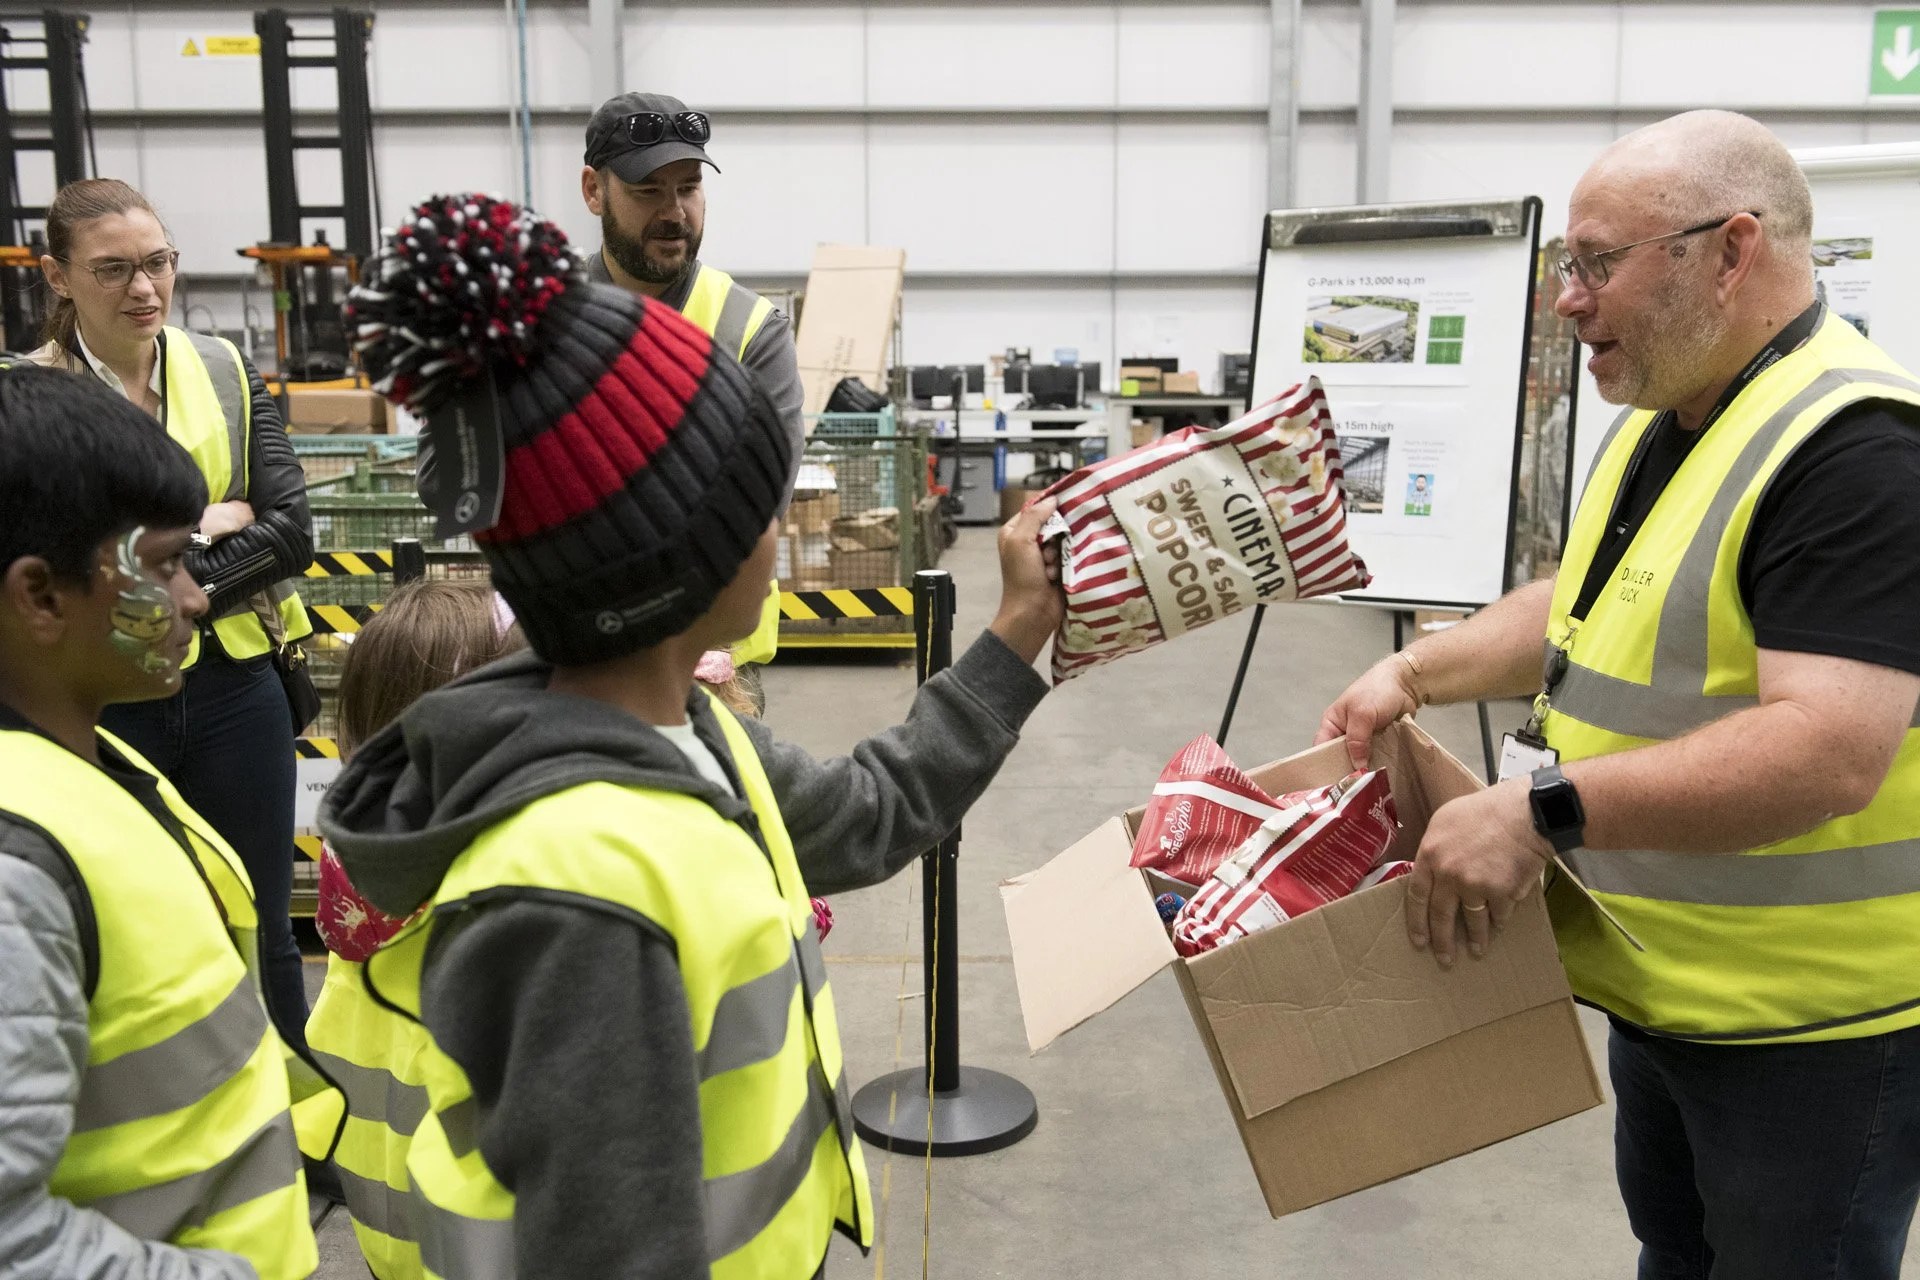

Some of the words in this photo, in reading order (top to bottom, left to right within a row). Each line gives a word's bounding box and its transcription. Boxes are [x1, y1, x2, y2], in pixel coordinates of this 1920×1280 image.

[1307, 276, 1343, 287] G-Park
[1346, 276, 1355, 286] is
[1359, 276, 1394, 287] 13,000
[1397, 276, 1425, 287] sq.m
[1345, 420, 1368, 431] 15m
[1370, 421, 1394, 433] high
[1170, 478, 1218, 551] SWEET
[1206, 556, 1226, 576] &
[1223, 493, 1285, 598] CINEMA
[1134, 488, 1216, 632] POPCOR
[1166, 840, 1183, 859] JOE
